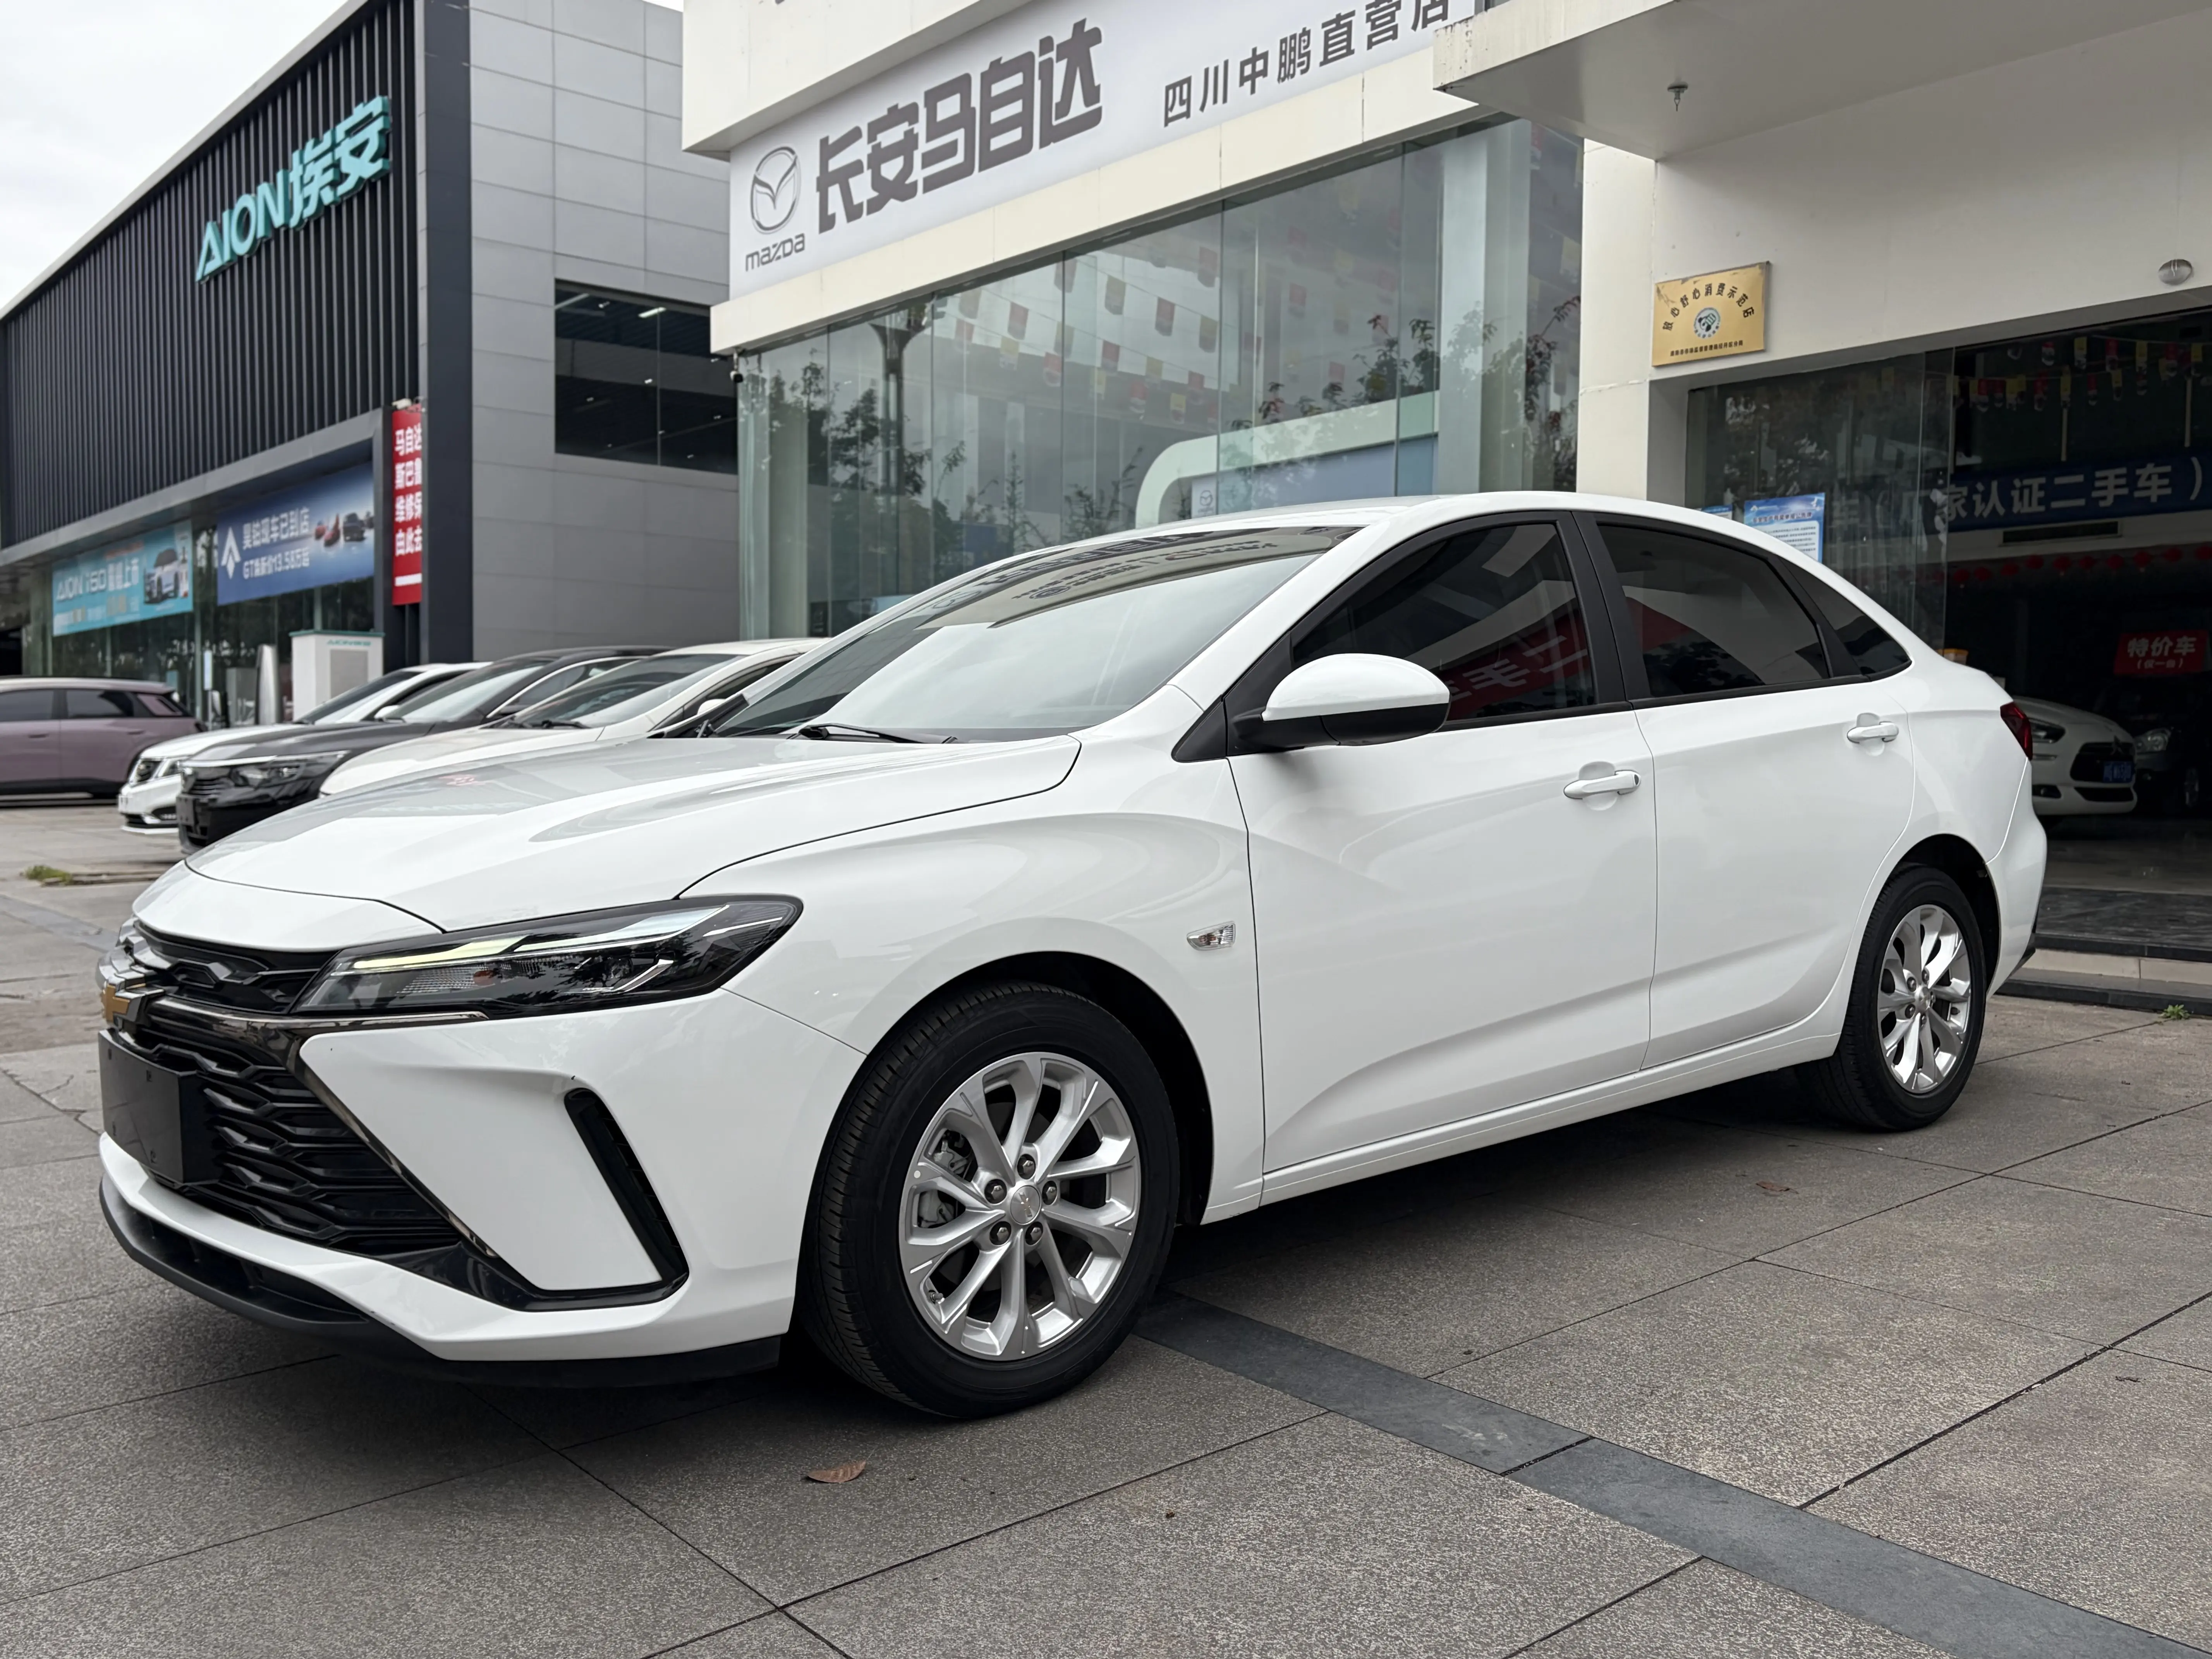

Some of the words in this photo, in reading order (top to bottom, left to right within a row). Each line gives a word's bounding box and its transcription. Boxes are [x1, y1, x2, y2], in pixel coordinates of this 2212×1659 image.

[816, 17, 1103, 234] 长安马自达
[745, 233, 805, 272] mazda
[1662, 283, 1754, 331] 放心舒心消费示范店
[2127, 635, 2197, 658] 特价车
